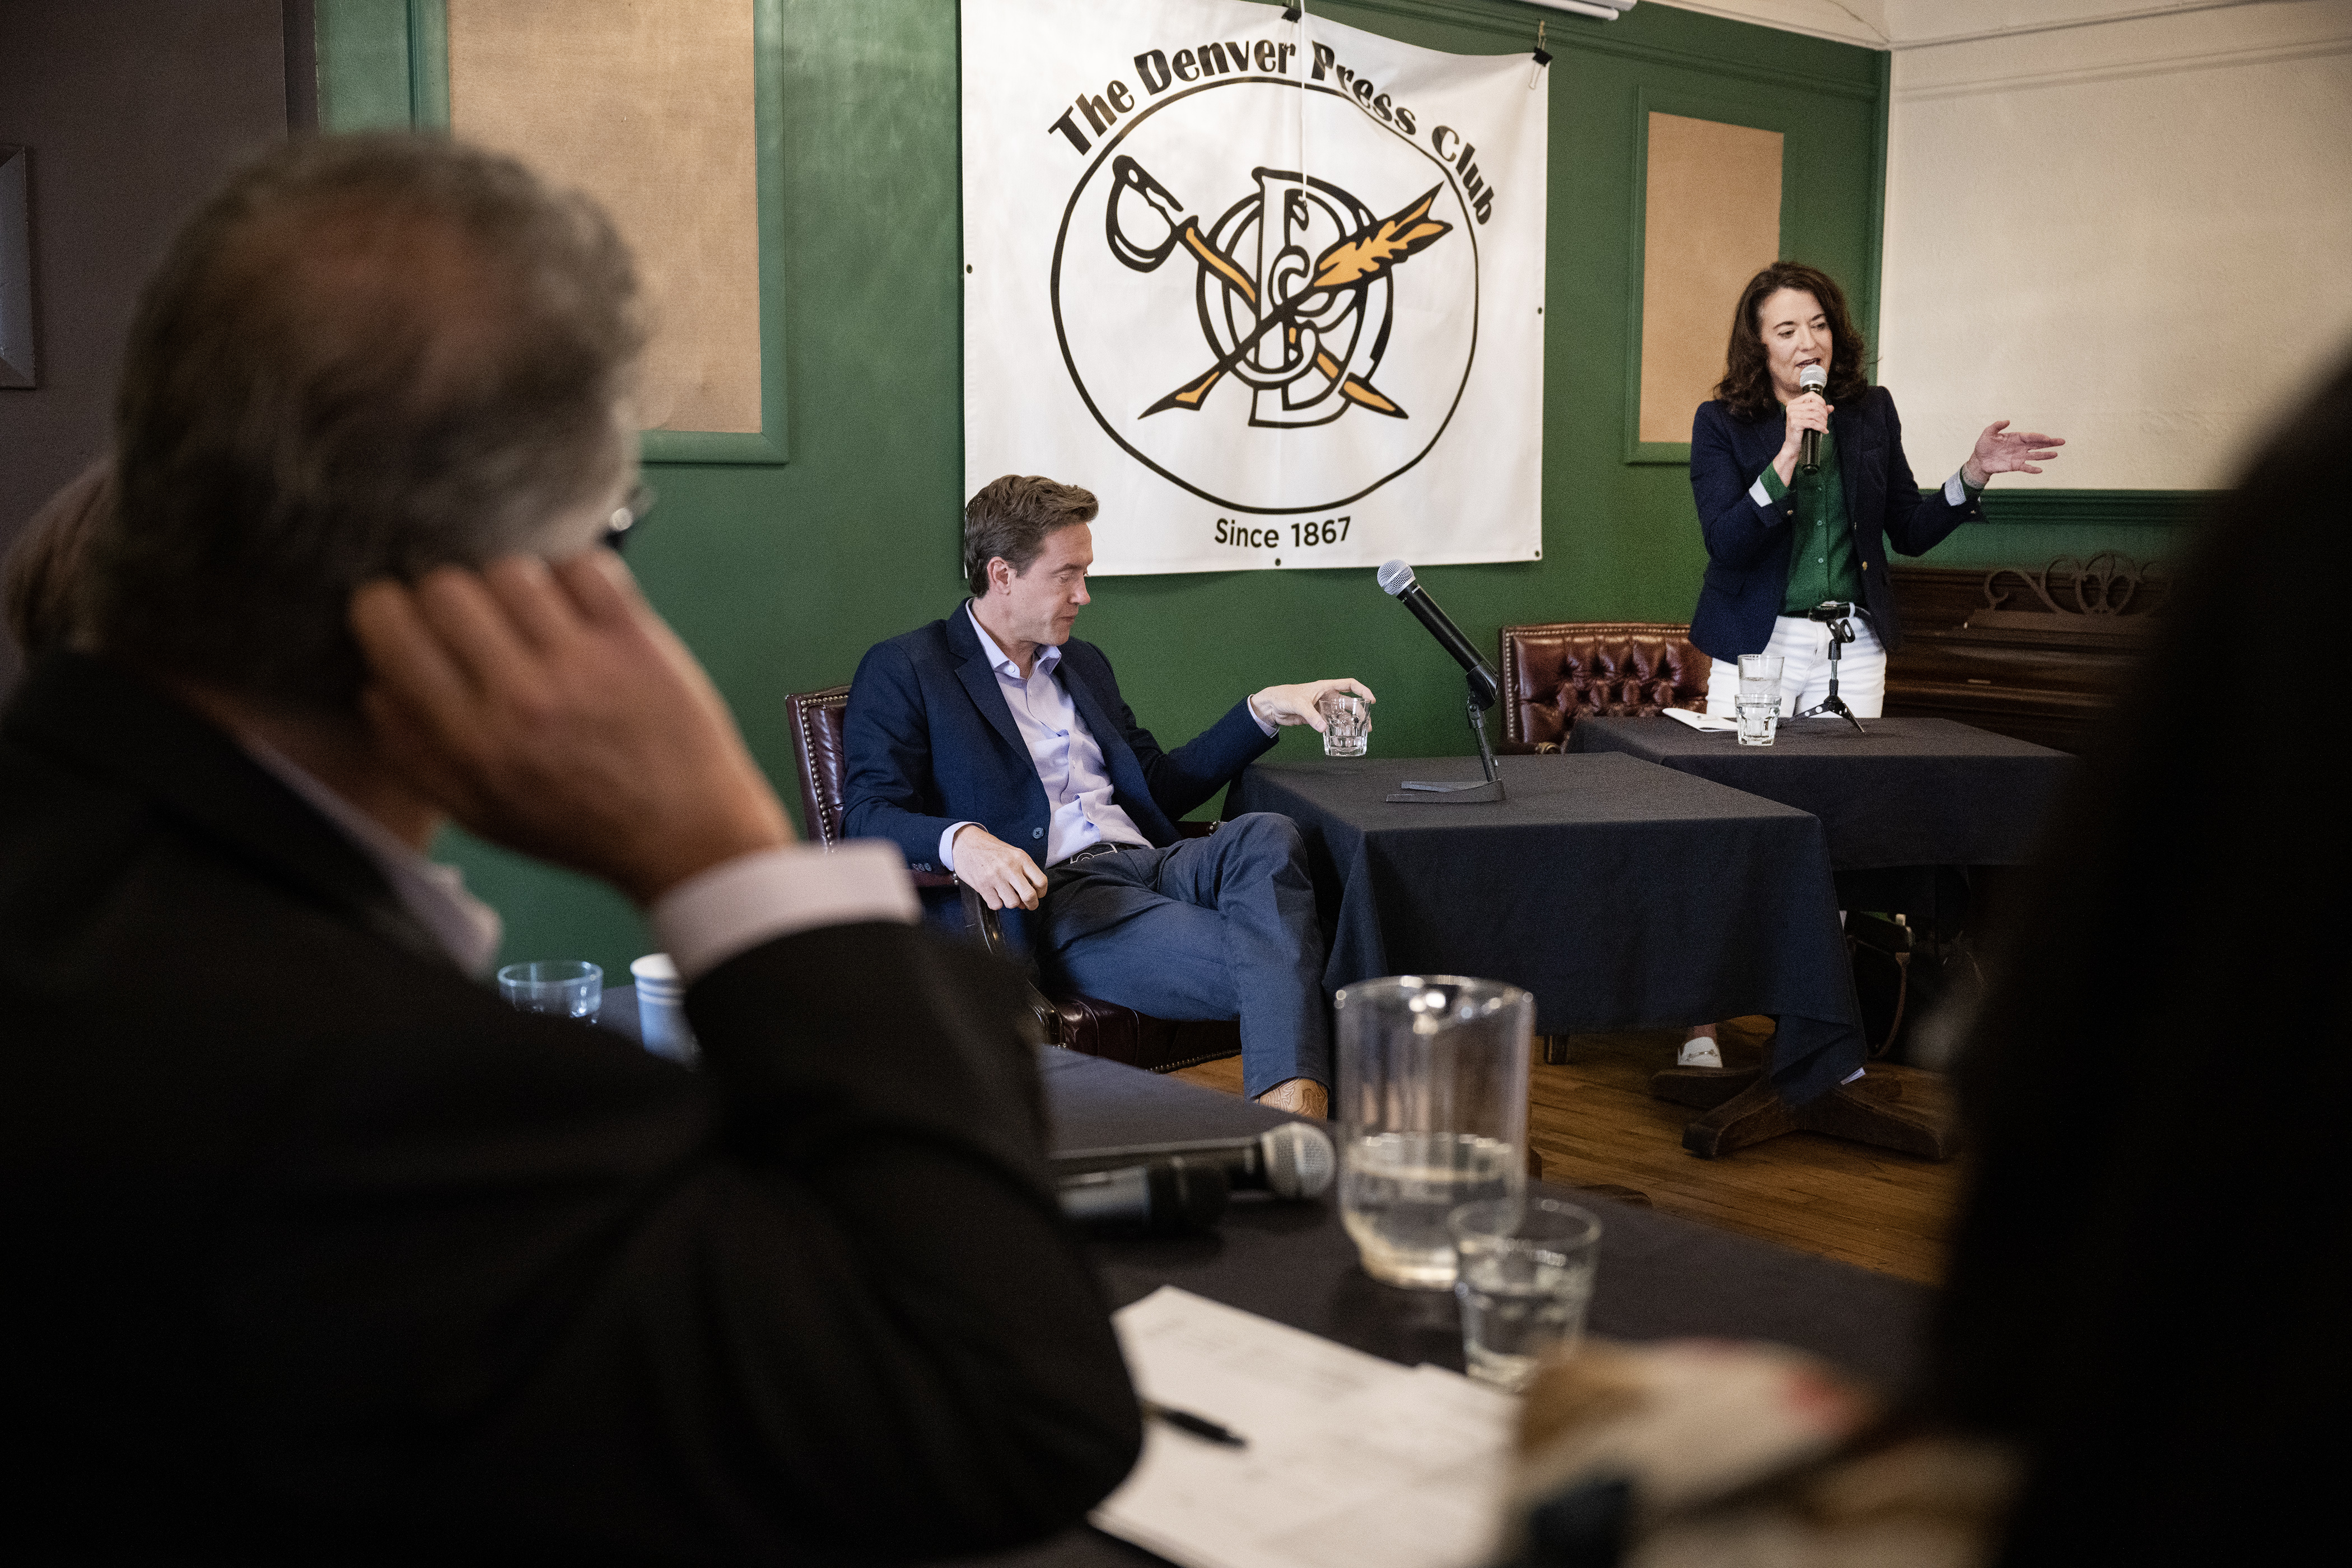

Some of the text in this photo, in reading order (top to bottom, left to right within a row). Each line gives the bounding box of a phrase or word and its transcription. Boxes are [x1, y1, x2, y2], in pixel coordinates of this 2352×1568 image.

[1047, 39, 1494, 225] The Denver Press Club
[1214, 516, 1351, 548] Since 1867
